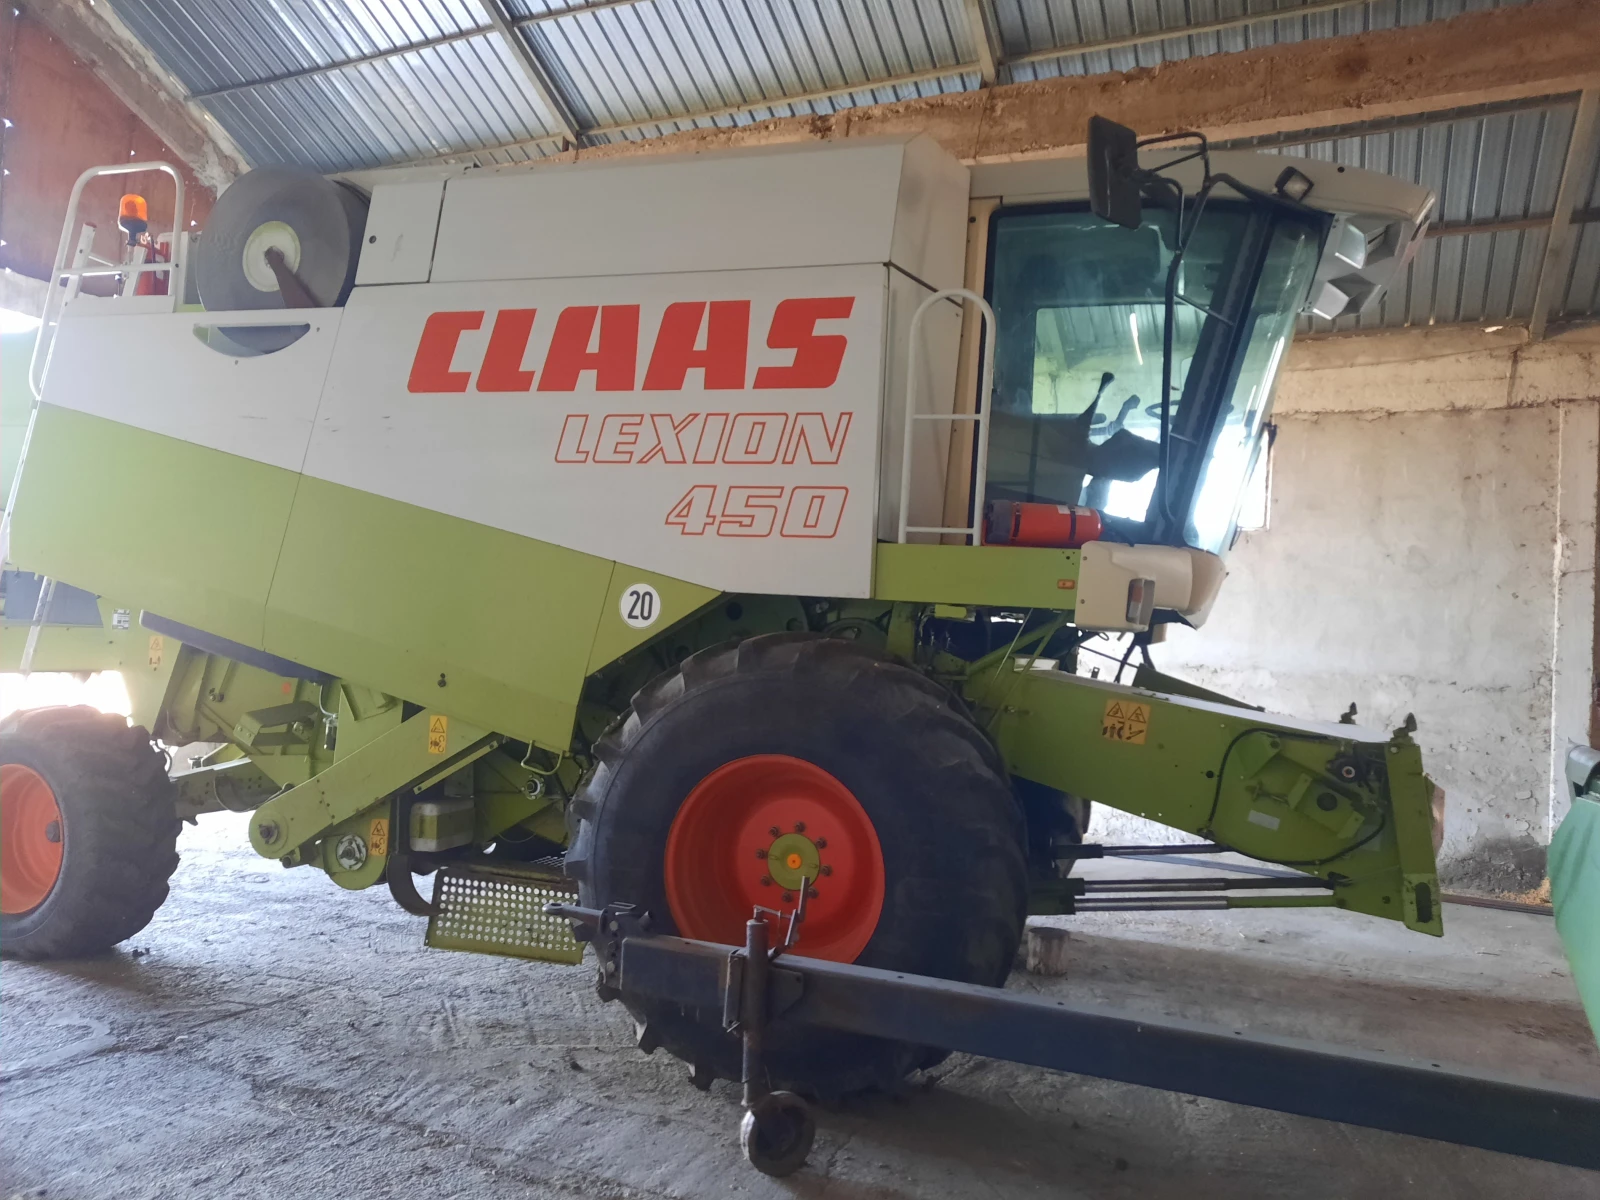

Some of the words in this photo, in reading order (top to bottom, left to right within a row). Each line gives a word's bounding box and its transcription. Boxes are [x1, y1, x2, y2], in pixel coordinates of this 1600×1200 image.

[407, 296, 855, 393] CLAAS
[554, 411, 854, 465] LEXION
[664, 484, 849, 538] 450
[627, 590, 654, 620] 20
